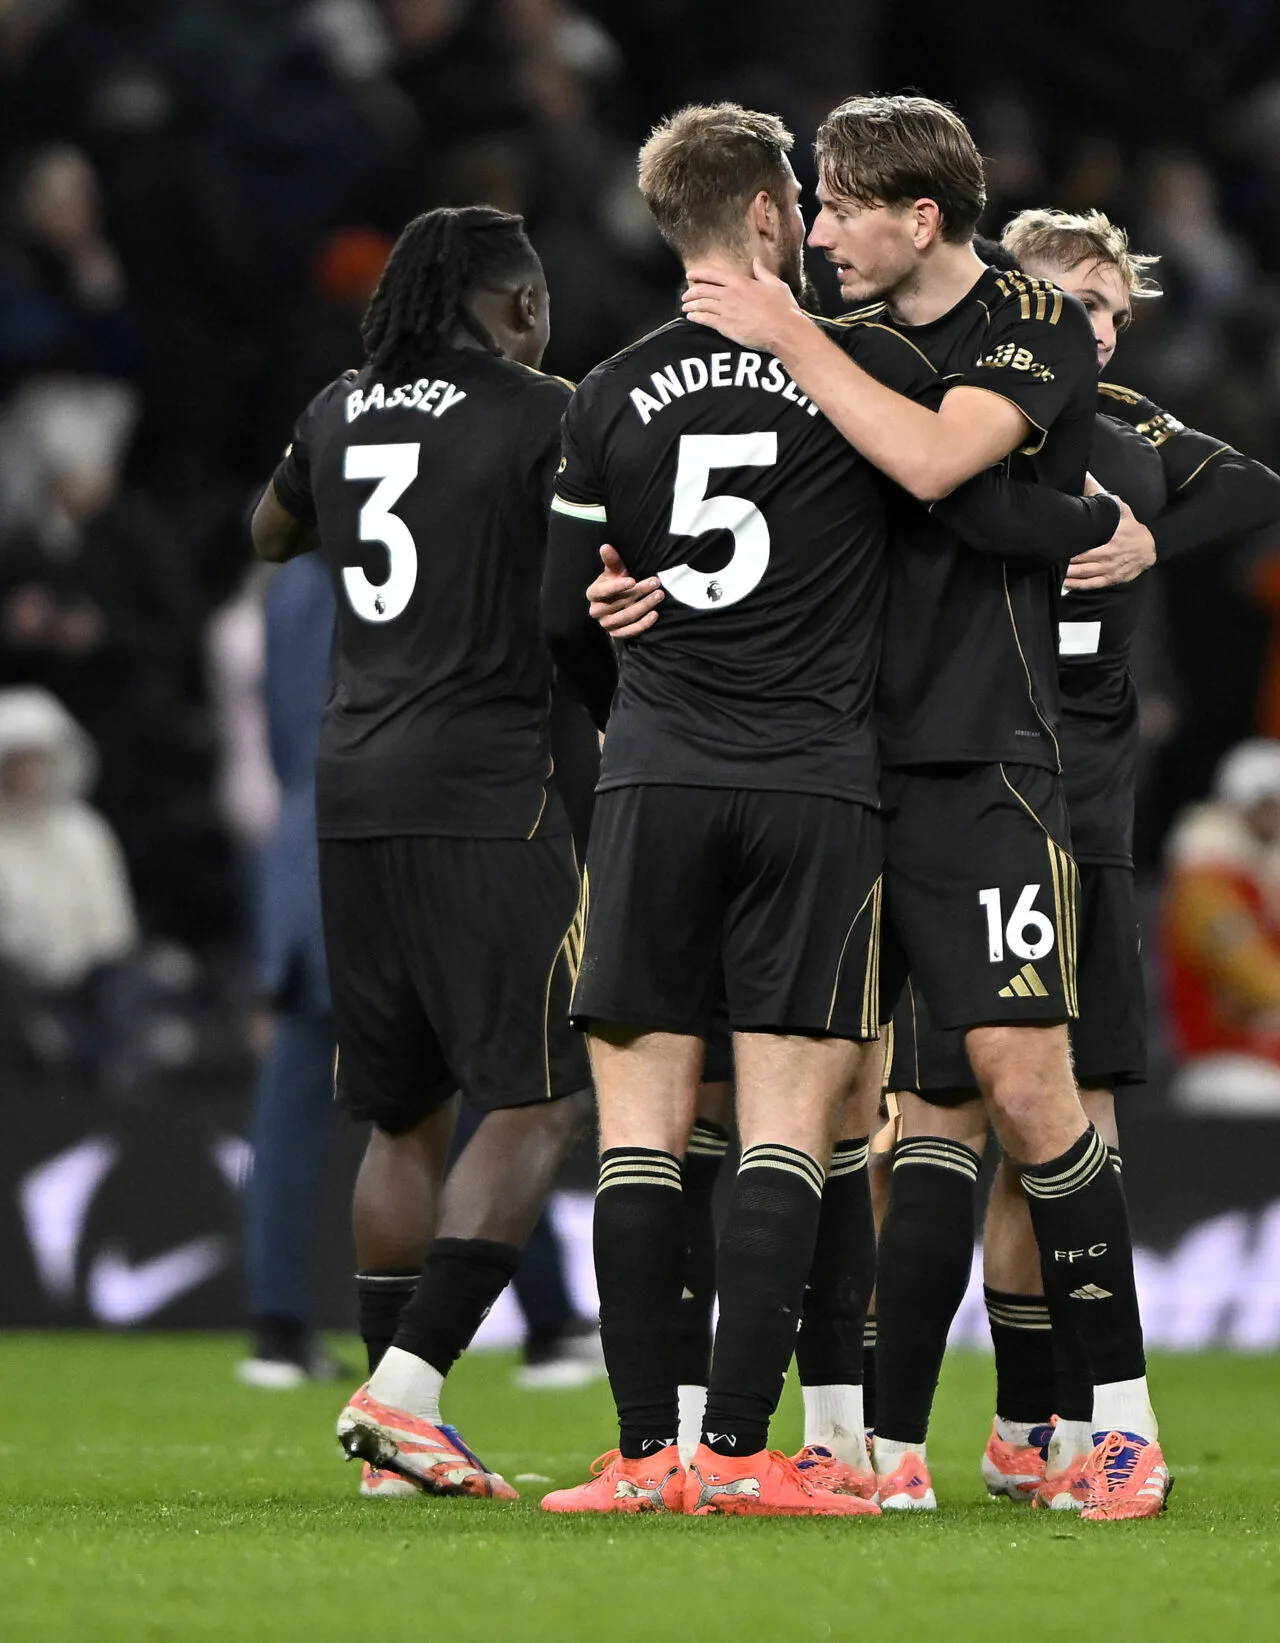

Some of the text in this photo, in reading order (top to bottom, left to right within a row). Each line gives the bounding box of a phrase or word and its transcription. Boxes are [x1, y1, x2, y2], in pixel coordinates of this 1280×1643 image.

[346, 378, 467, 423] BASSEY
[630, 351, 819, 424] ANDERS
[343, 443, 420, 623] 3
[657, 432, 777, 609] 5
[979, 884, 1055, 963] 16
[1054, 1243, 1107, 1263] FFC
